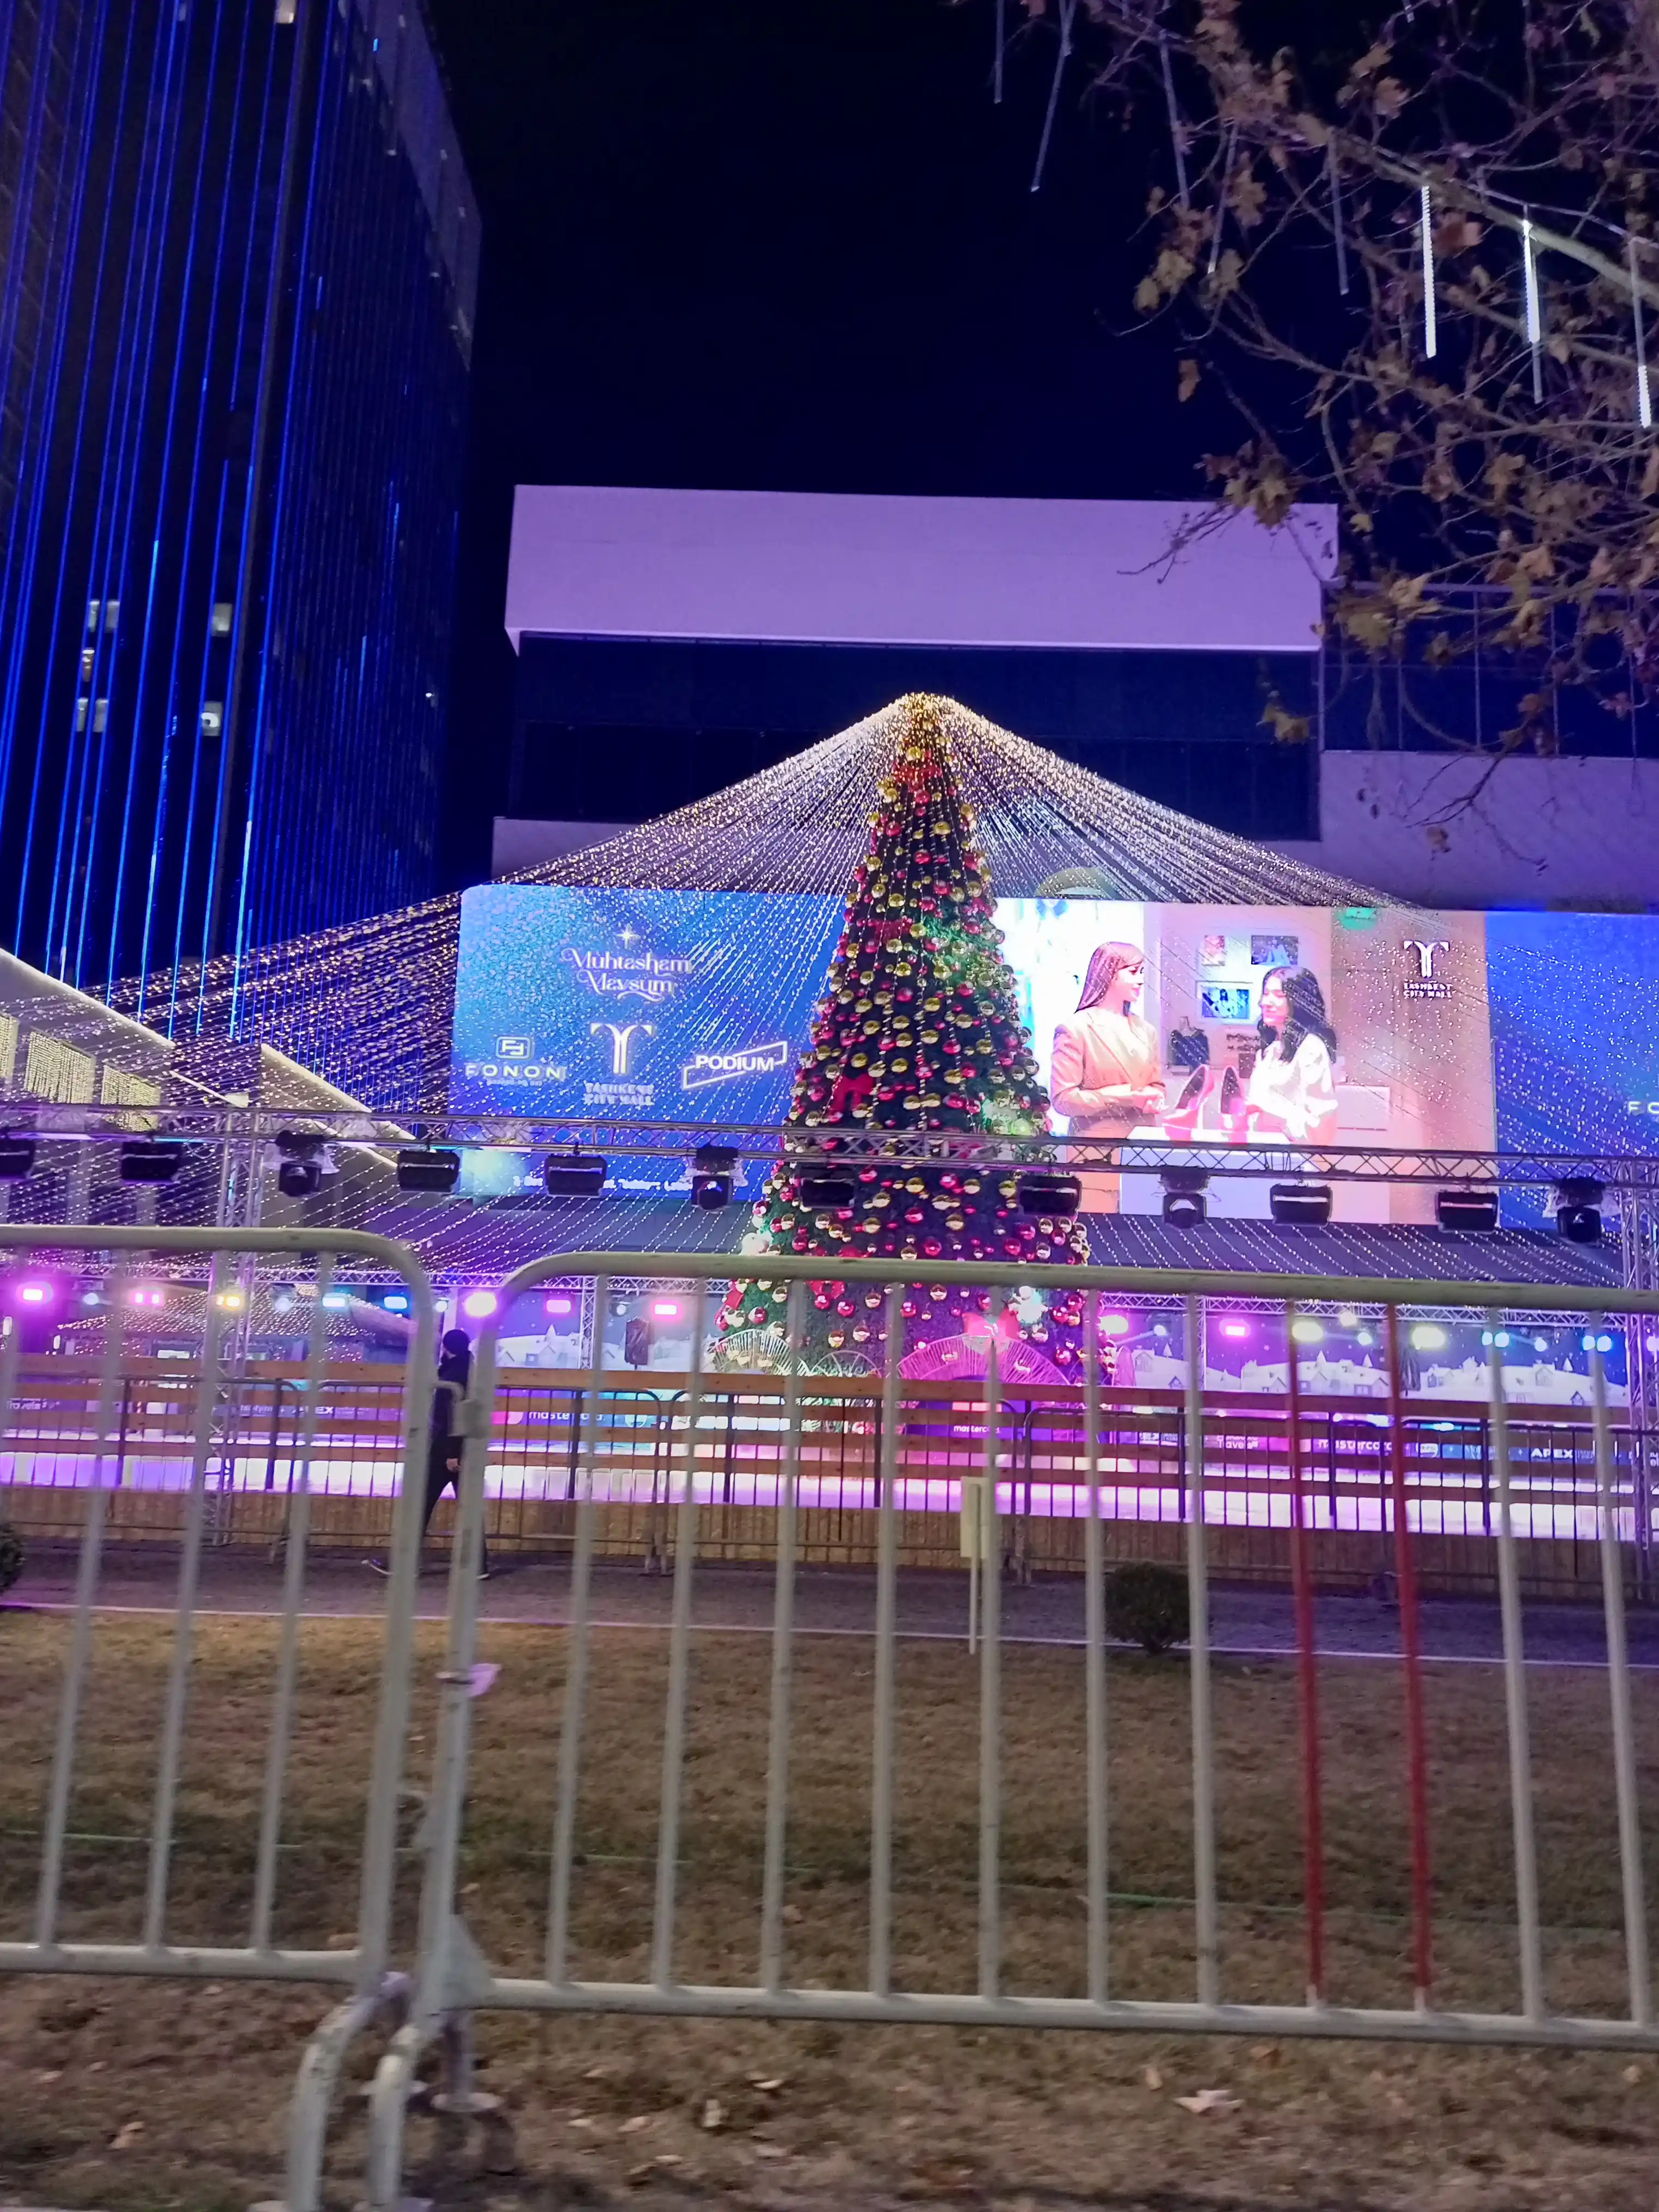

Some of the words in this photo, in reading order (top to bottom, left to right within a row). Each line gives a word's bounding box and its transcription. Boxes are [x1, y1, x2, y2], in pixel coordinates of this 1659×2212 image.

[561, 948, 693, 978] Muhtasham
[464, 1064, 563, 1080] FONON
[695, 1054, 775, 1072] PODIUM
